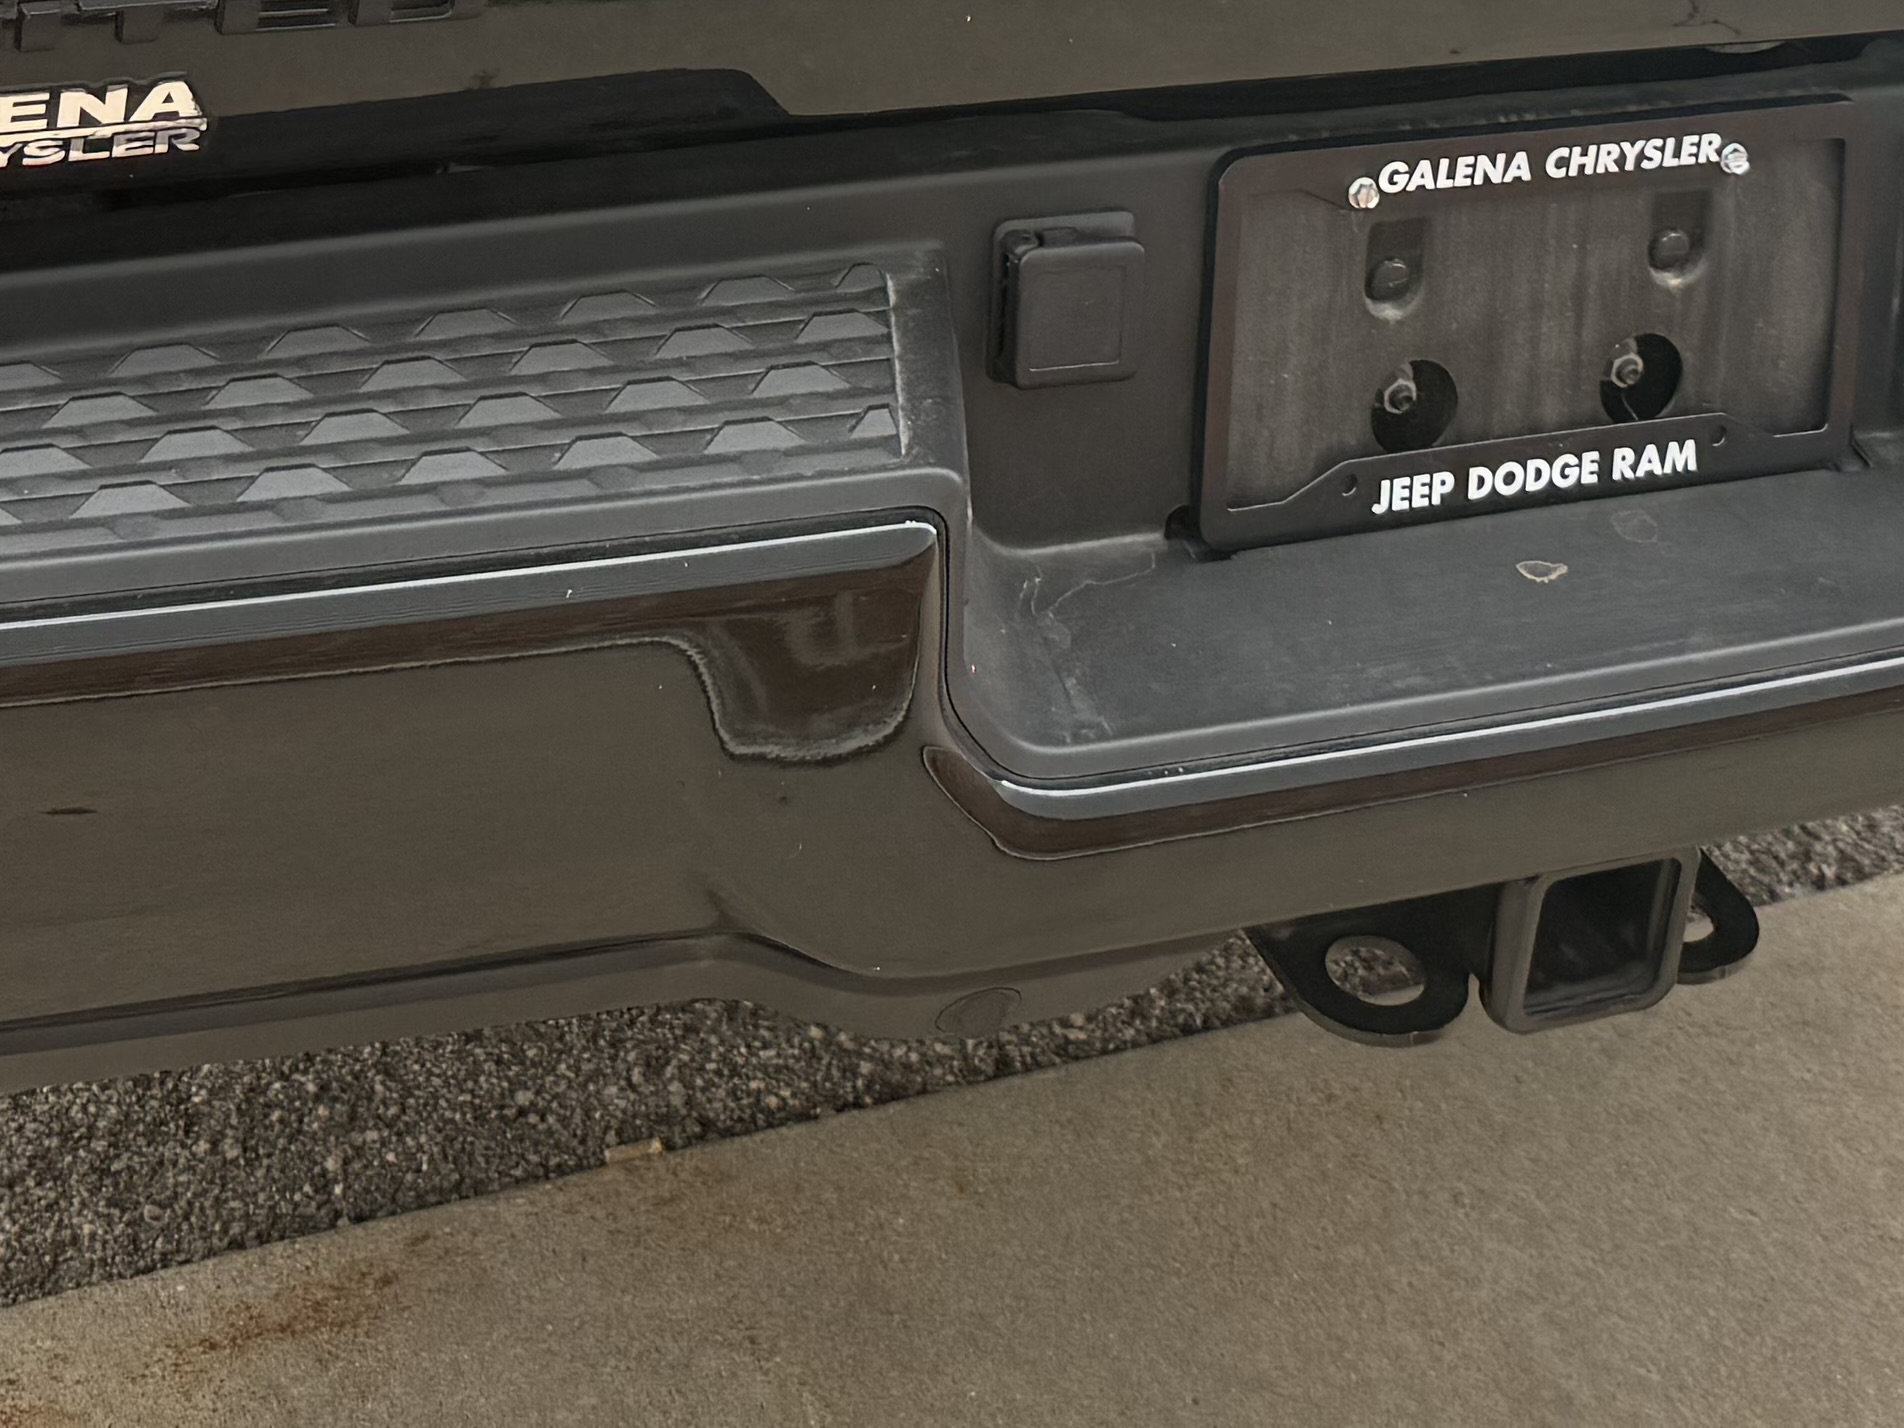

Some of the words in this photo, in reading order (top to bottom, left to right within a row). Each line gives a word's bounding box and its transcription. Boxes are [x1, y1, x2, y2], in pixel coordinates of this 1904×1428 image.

[1377, 148, 1532, 195] GALENA
[1544, 131, 1724, 179] CHRYSLER
[1370, 473, 1456, 515] JEEP
[1466, 449, 1600, 502] DODGE
[1611, 438, 1698, 480] RAM
